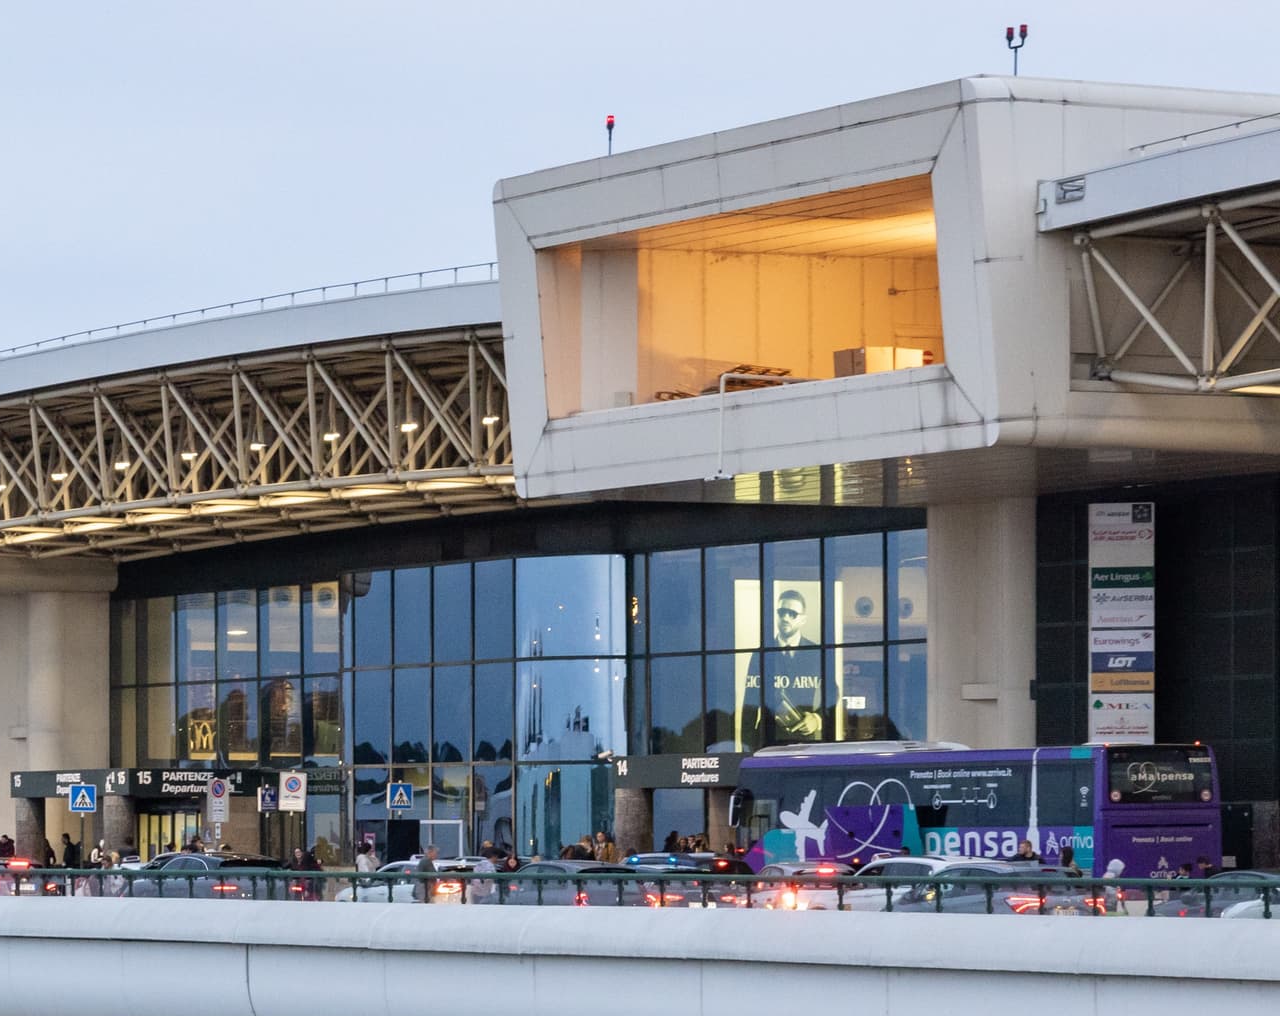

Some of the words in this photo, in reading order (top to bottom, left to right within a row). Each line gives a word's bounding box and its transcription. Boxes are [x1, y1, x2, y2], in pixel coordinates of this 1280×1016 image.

[1110, 571, 1141, 583] Lingus
[1093, 637, 1141, 647] Eurowings
[1108, 656, 1137, 668] LOT
[1107, 703, 1152, 711] MEA
[616, 760, 628, 776] 14
[681, 757, 719, 769] PARTENZE
[117, 771, 126, 785] 15
[136, 770, 152, 785] 15
[162, 771, 214, 781] PARTENZE
[680, 772, 720, 785] Departures
[161, 783, 208, 795] Departure
[1060, 832, 1095, 849] arriva
